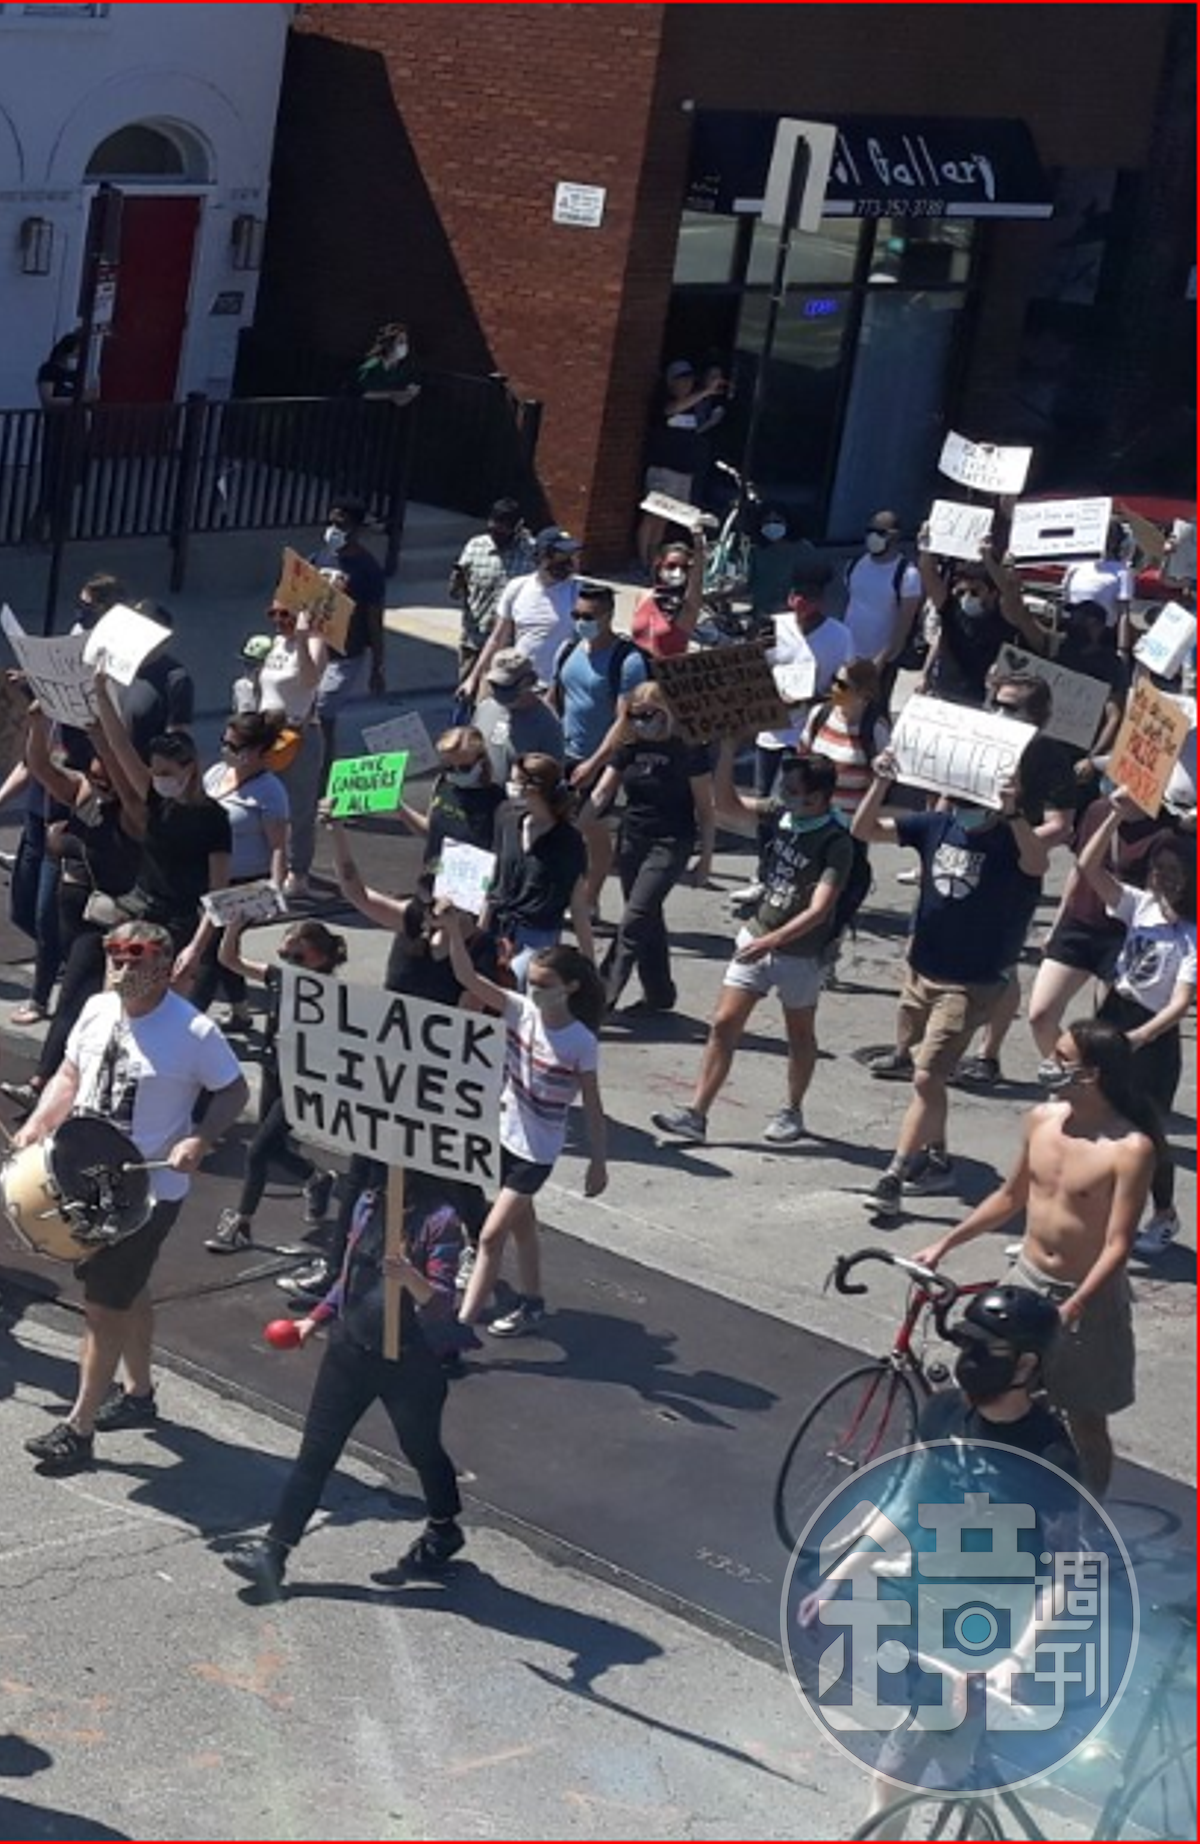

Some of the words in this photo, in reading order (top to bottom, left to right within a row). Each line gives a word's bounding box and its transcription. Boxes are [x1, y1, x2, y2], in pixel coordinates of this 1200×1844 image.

[867, 137, 996, 200] Gallery
[293, 975, 495, 1070] BLACK
[295, 1030, 485, 1120] LIVES
[292, 1084, 494, 1179] MATTER
